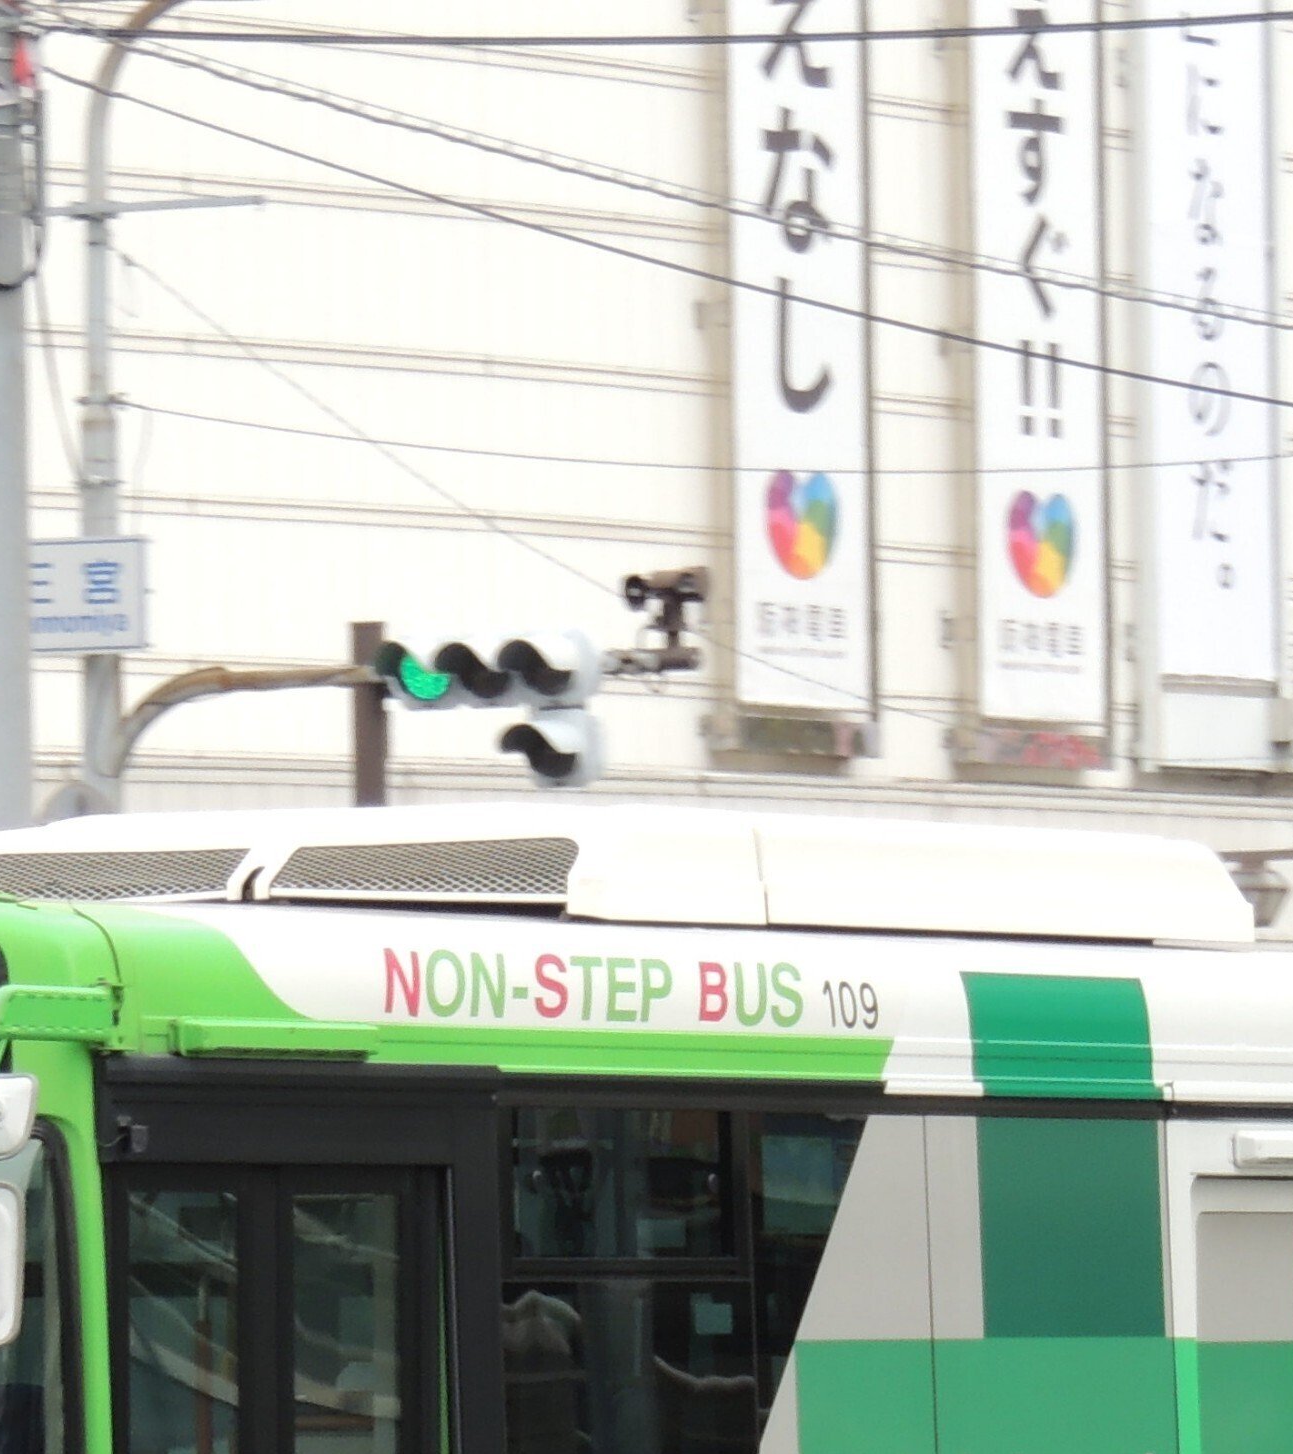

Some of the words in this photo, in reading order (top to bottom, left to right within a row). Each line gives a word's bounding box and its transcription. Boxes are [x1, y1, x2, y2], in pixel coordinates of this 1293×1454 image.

[382, 946, 673, 1024] NON-STEP
[697, 961, 804, 1029] BUS
[822, 980, 879, 1030] 109
